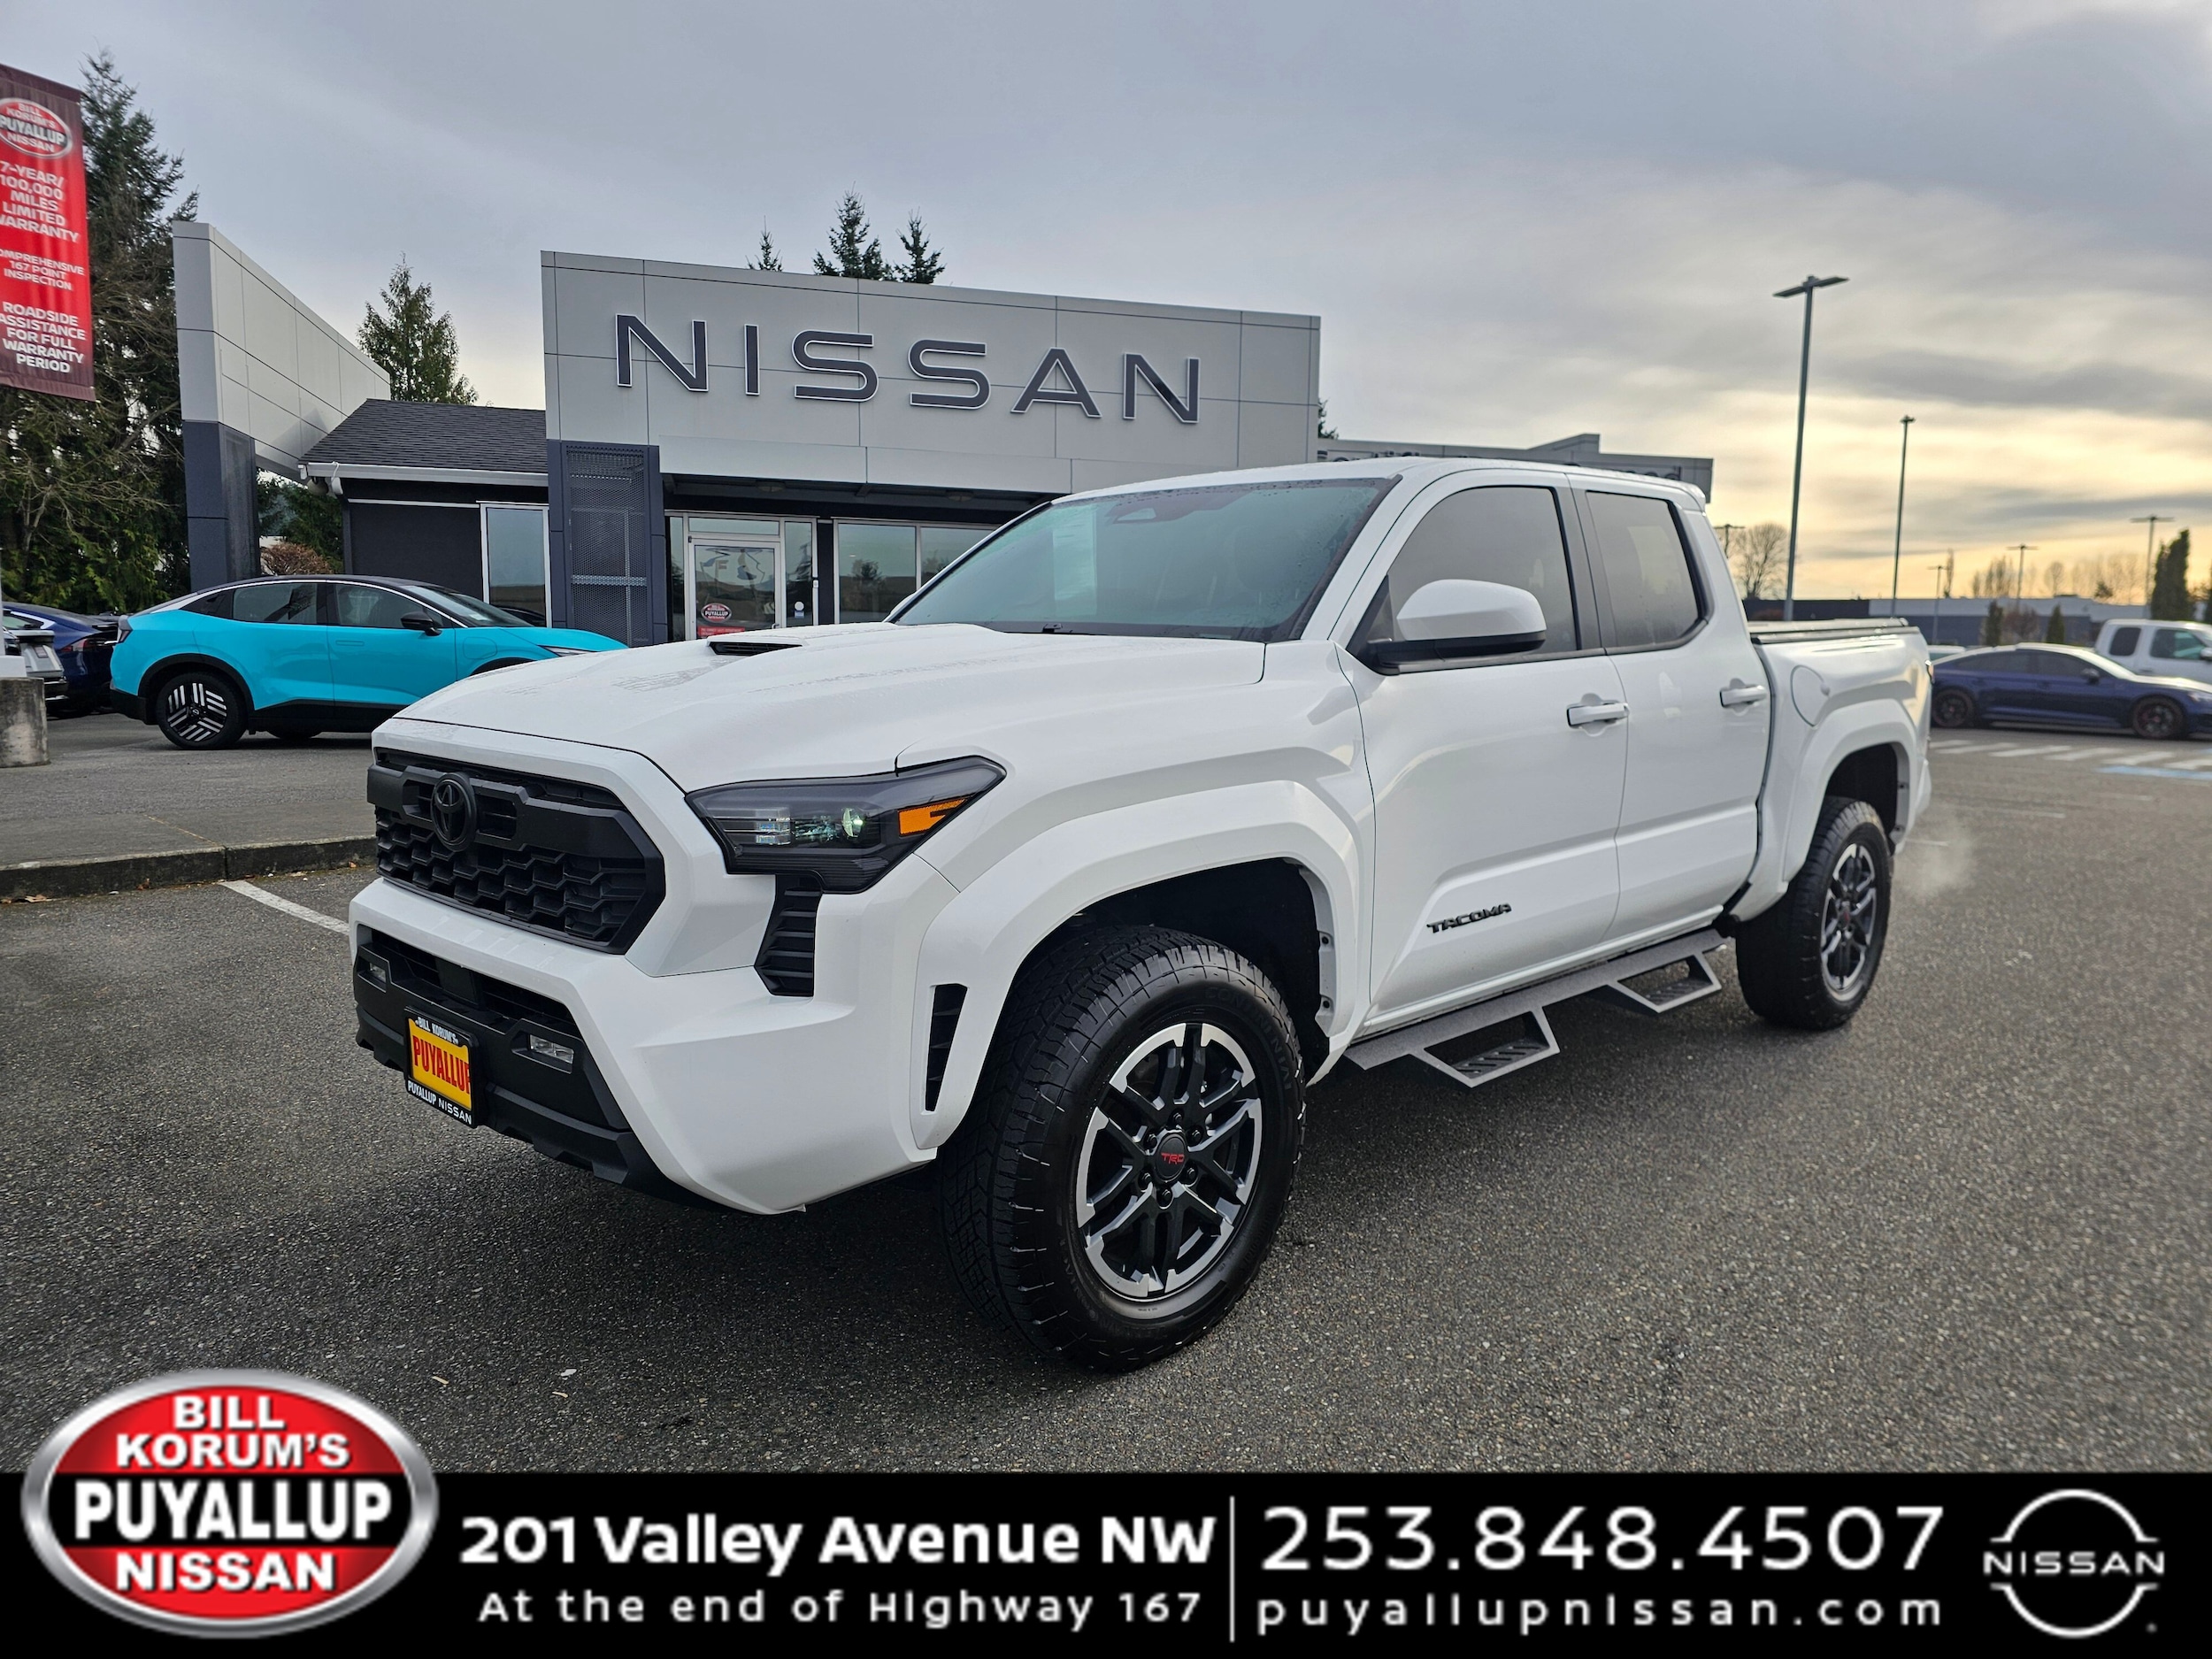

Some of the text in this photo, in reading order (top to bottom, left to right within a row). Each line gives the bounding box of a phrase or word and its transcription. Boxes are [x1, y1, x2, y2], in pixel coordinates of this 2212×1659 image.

[18, 103, 42, 117] BILL
[0, 114, 65, 145] PUYALLUP
[7, 131, 55, 152] NISSAN
[0, 160, 64, 188] 7-YEAR/
[11, 190, 58, 211] MILES
[3, 201, 65, 226] LIMITED
[4, 268, 73, 290] INSPECTION
[10, 260, 66, 280] 167 POINT
[3, 302, 79, 326] ROADSIDE
[0, 313, 86, 340] ASSISTANCE
[7, 326, 76, 350] FOR FULL
[3, 338, 84, 364] WARRANTY
[16, 354, 70, 373] PERIOD
[616, 314, 1200, 424] NISSAN
[1426, 903, 1512, 933] TACOMA
[418, 1016, 457, 1044] BILL KORUM'S
[407, 1079, 472, 1126] PUYALLUP NISSAN
[1161, 1152, 1185, 1165] TRD
